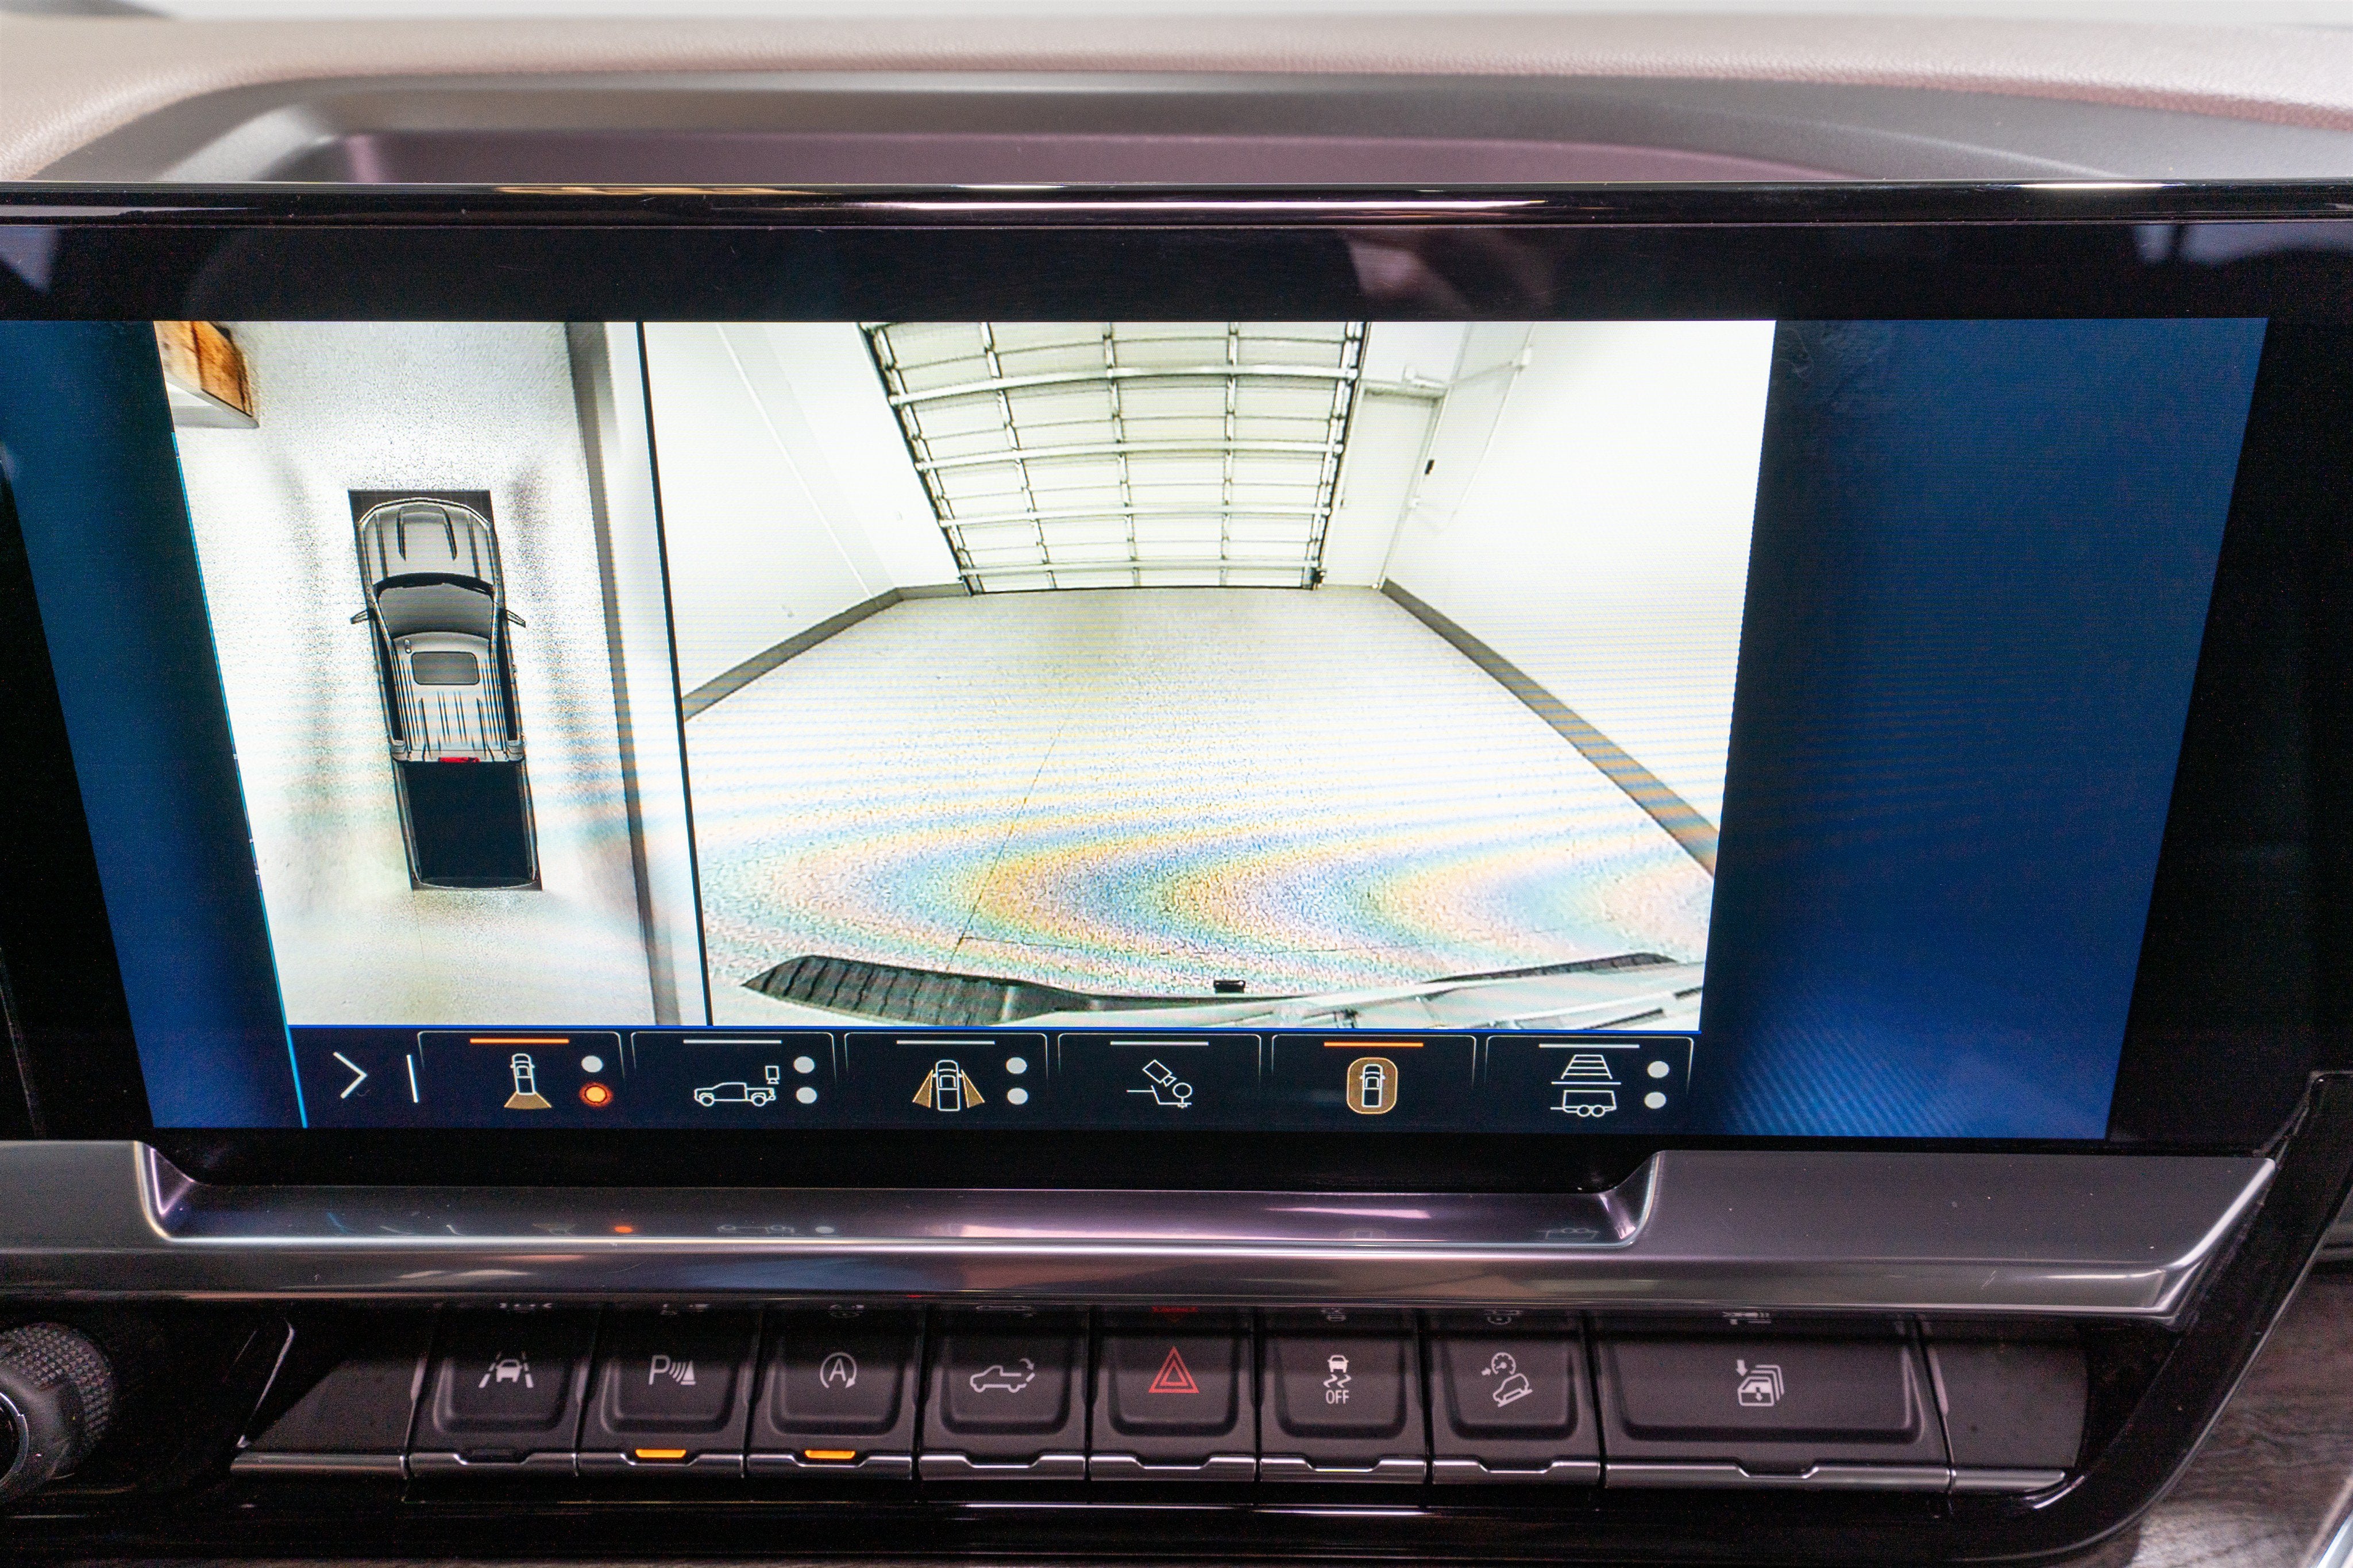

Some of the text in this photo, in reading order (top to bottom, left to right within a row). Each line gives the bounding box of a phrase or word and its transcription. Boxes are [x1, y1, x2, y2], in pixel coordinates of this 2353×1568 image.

[649, 1355, 671, 1385] P
[828, 1358, 846, 1382] A
[1325, 1389, 1349, 1404] OFF
